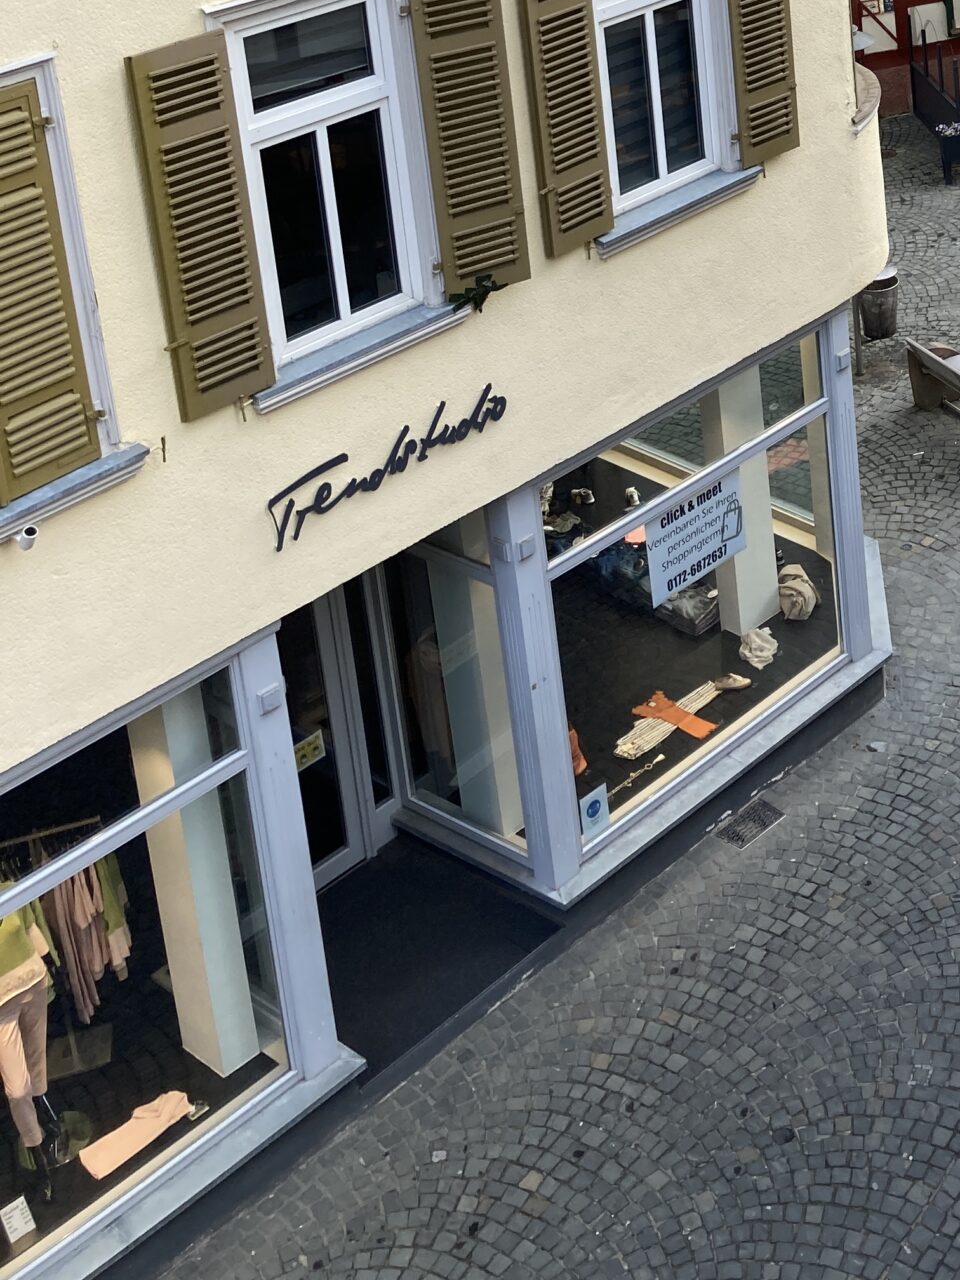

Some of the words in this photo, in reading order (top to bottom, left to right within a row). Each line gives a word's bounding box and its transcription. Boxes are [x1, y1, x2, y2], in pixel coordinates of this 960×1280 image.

[268, 382, 507, 552] Trendstudio
[647, 515, 701, 552] Vereinbaren
[702, 506, 714, 519] Sie
[715, 491, 738, 509] Ihren
[660, 504, 686, 529] click
[687, 500, 696, 512] &
[696, 481, 722, 506] meet
[662, 524, 729, 572] Shoppingtermin
[667, 515, 721, 557] persönlichen
[667, 543, 728, 592] 0172-6872637
